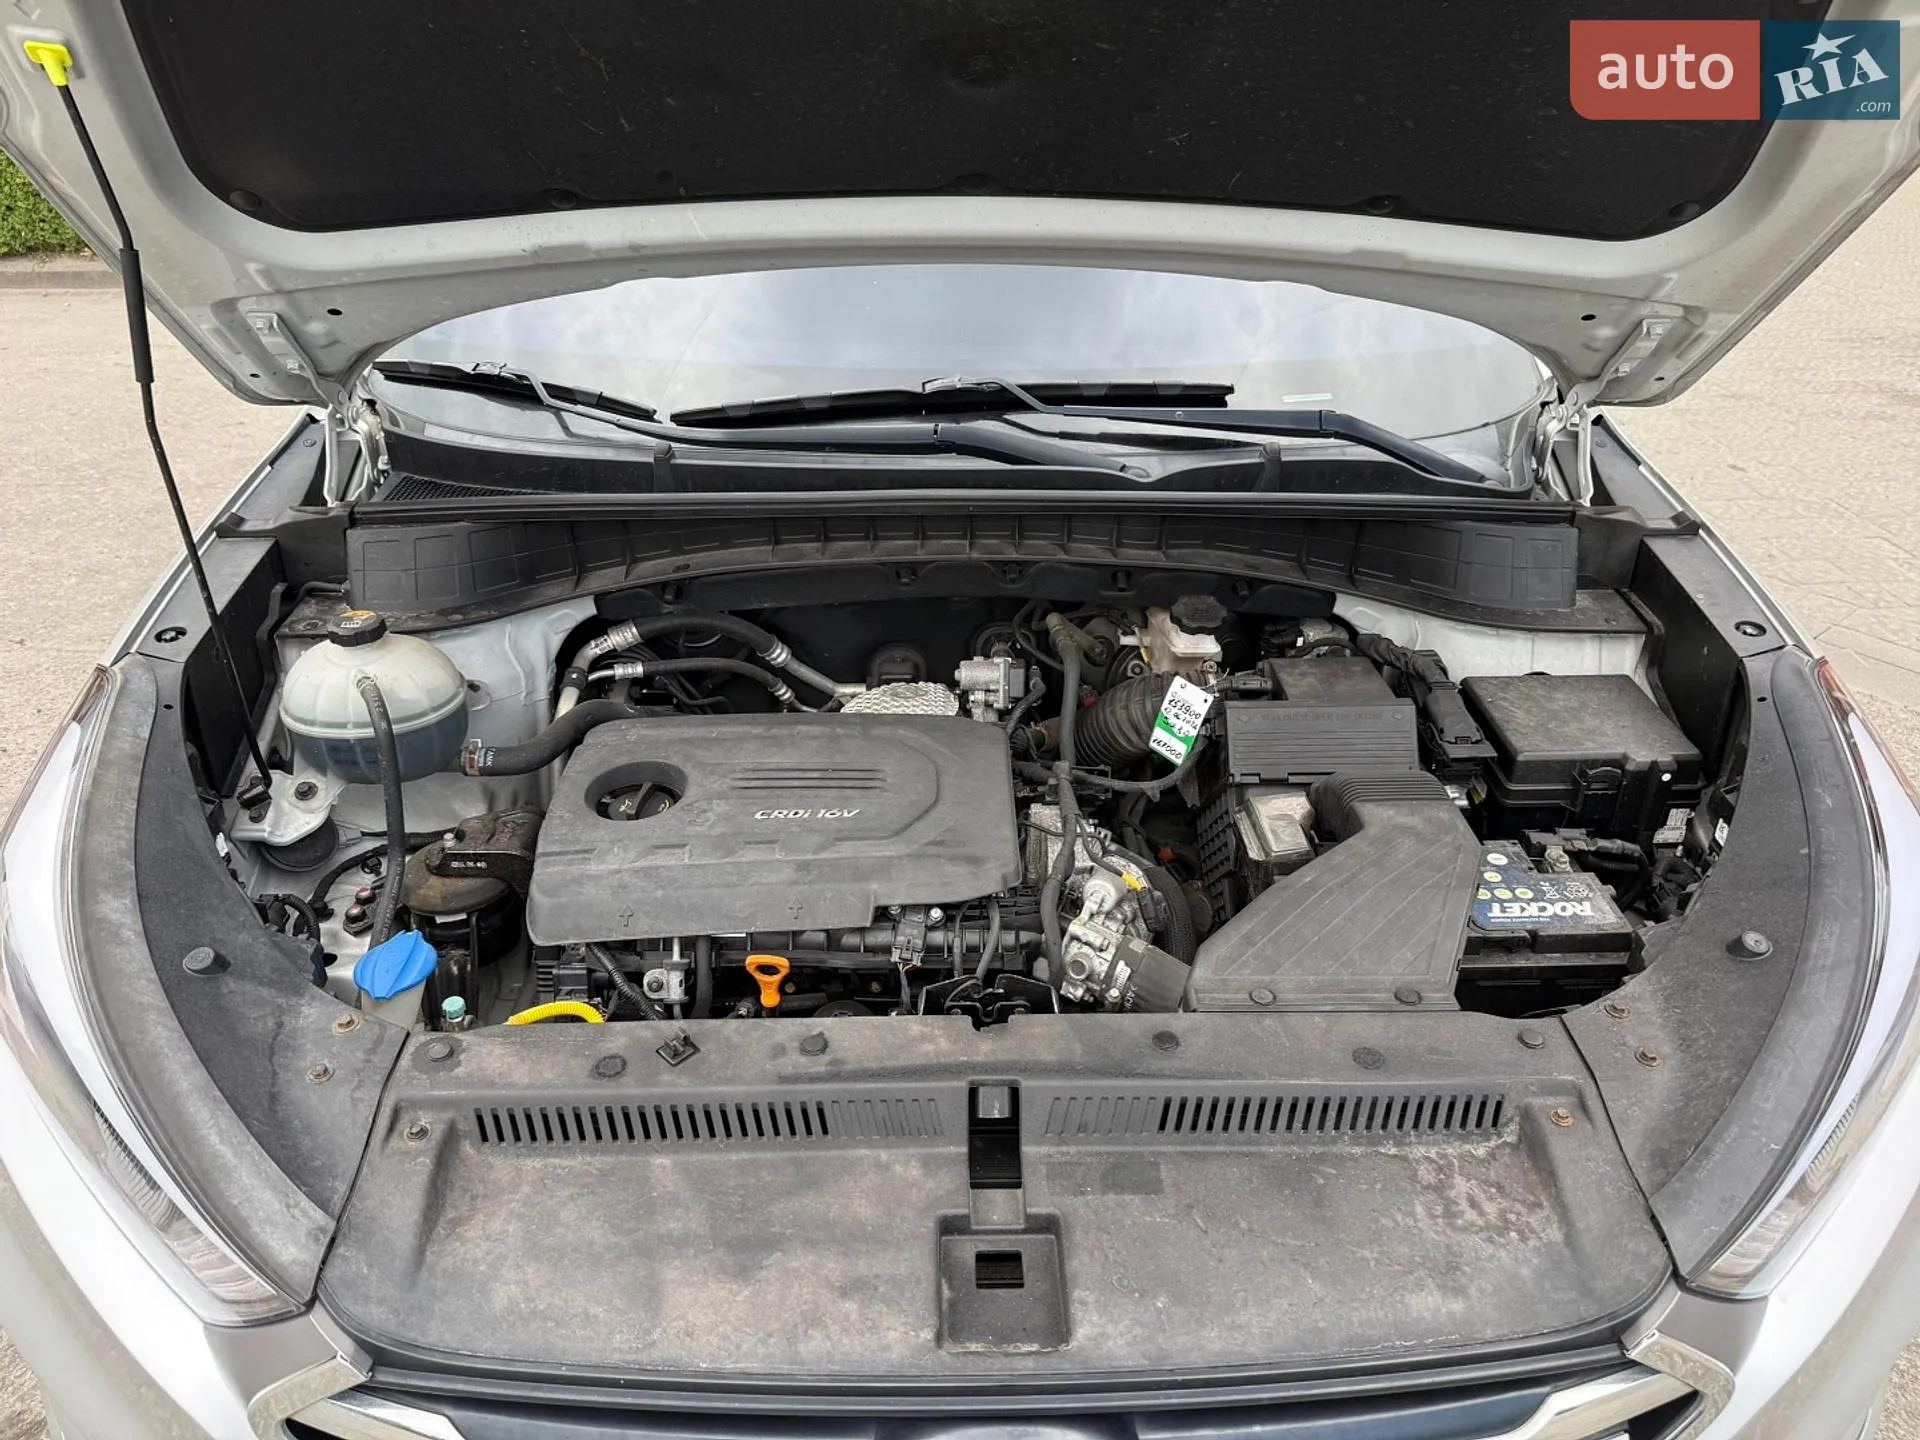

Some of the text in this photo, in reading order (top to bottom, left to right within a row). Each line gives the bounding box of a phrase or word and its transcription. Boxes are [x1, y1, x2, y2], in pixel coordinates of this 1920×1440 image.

[754, 808, 861, 819] CRDi 16V
[1488, 901, 1595, 917] ROCKET
